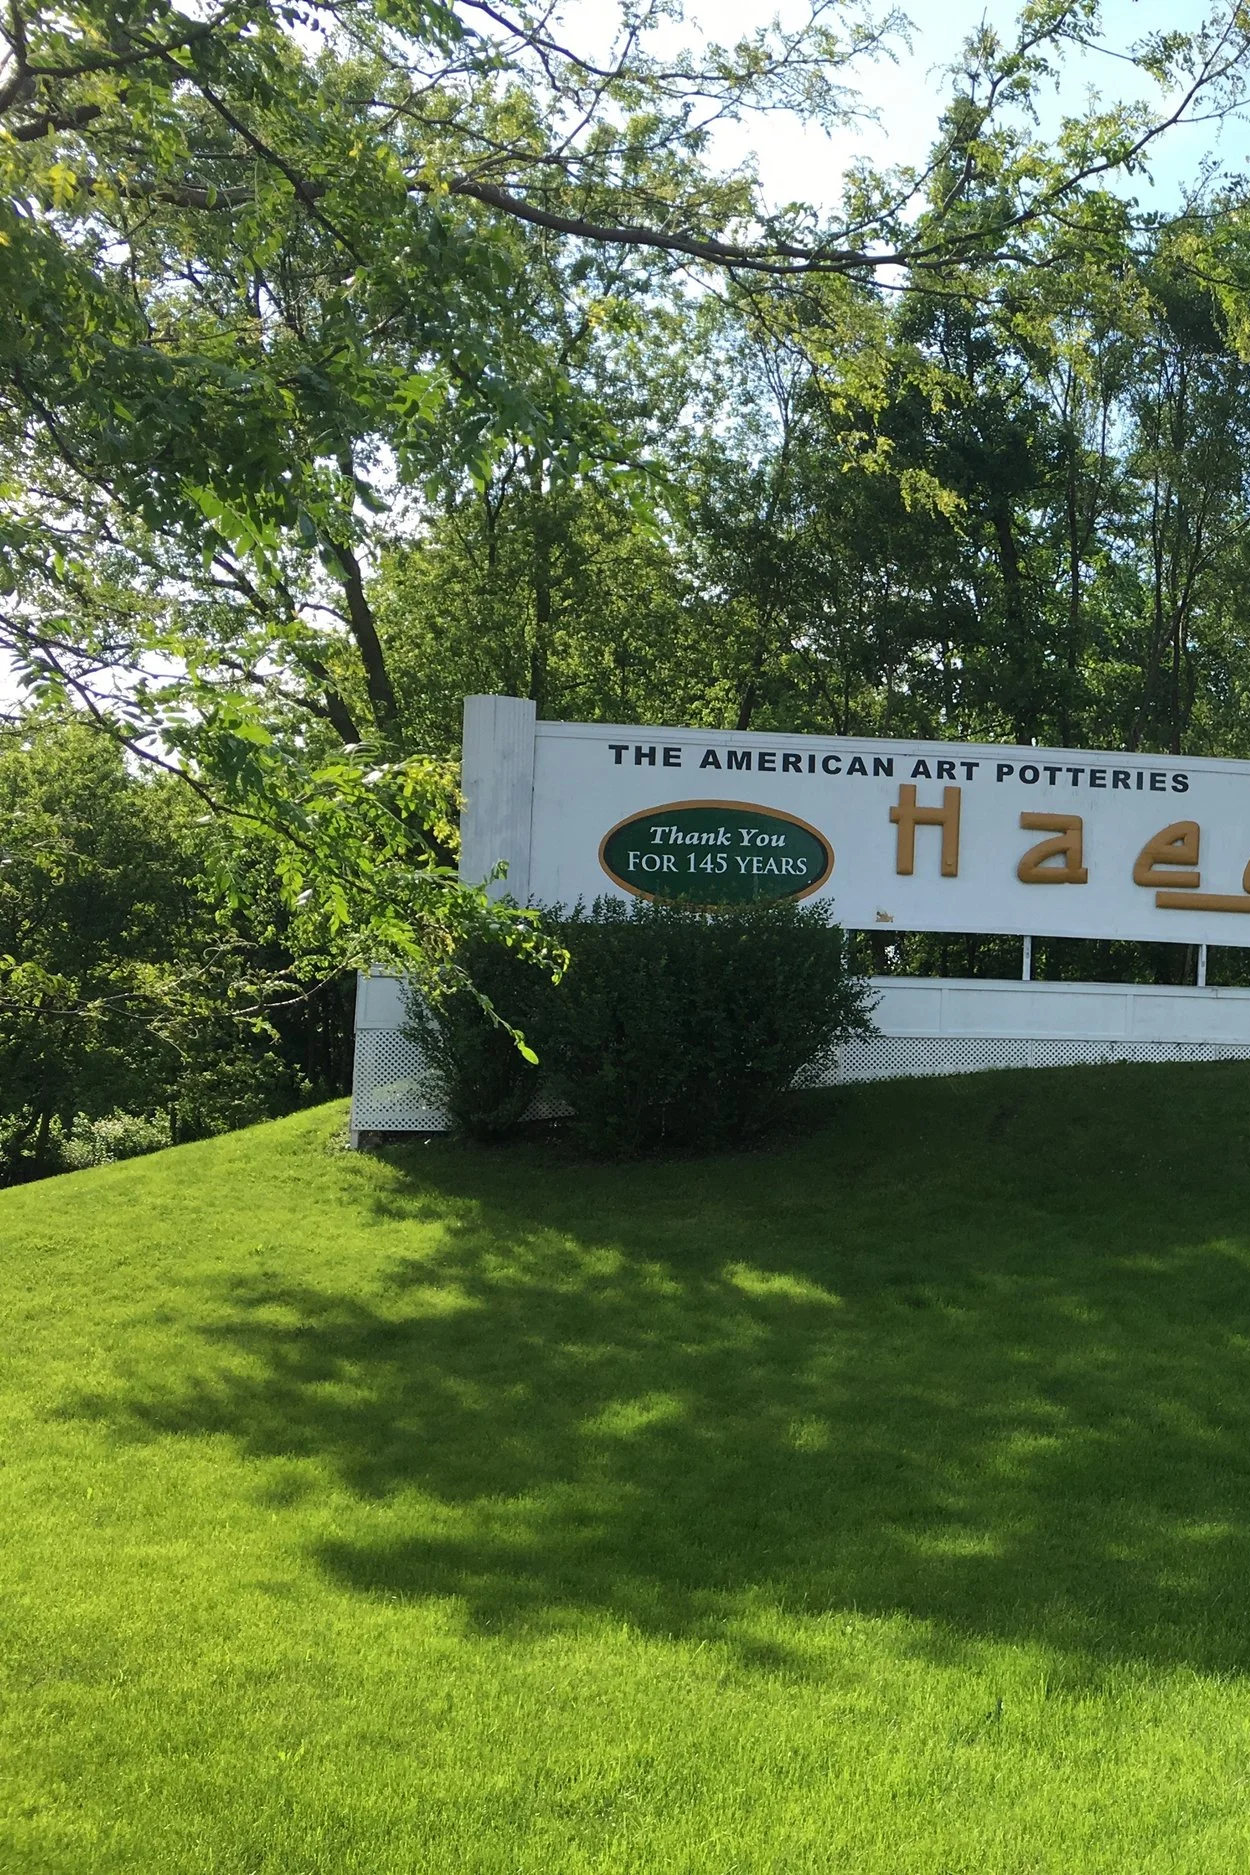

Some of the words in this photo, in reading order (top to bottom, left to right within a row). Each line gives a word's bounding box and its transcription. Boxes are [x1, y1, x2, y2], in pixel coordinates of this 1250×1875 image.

[608, 744, 682, 768] THE
[699, 749, 894, 777] AMERICAN
[910, 759, 981, 782] ART
[995, 763, 1191, 793] POTTERIES
[649, 826, 731, 846] Thank
[738, 829, 786, 847] You
[627, 851, 678, 872] FOR
[687, 853, 728, 873] 145
[735, 856, 807, 875] YEARS
